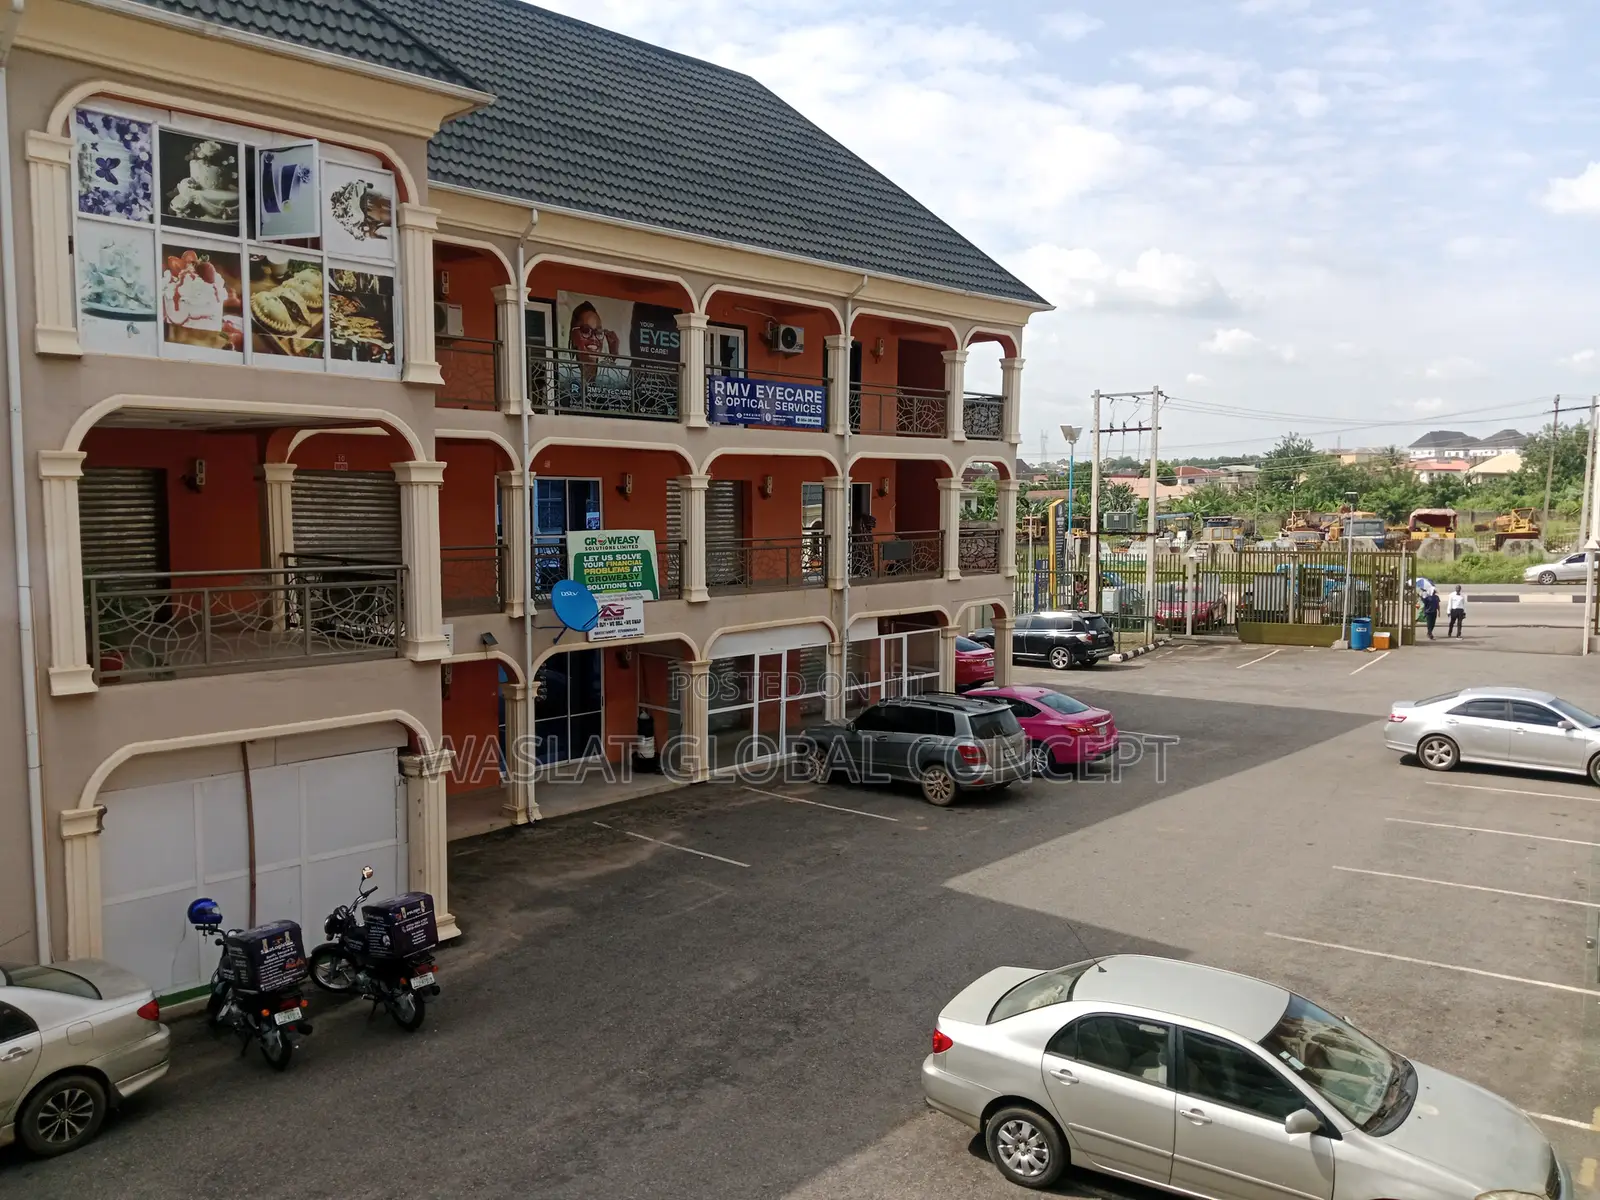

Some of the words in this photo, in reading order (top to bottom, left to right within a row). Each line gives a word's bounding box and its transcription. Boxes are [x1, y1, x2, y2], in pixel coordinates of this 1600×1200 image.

[640, 328, 680, 348] EYES
[650, 347, 669, 355] CARE!
[714, 380, 751, 397] RMV
[756, 384, 823, 403] EYECARE
[714, 396, 723, 406] &
[726, 396, 770, 410] OPTICAL
[775, 401, 822, 414] SERVICES
[584, 534, 640, 546] GROWEASY
[584, 566, 630, 575] PROBLEMS
[588, 573, 640, 582] GROWEASY
[586, 582, 627, 590] SOLUTIONS
